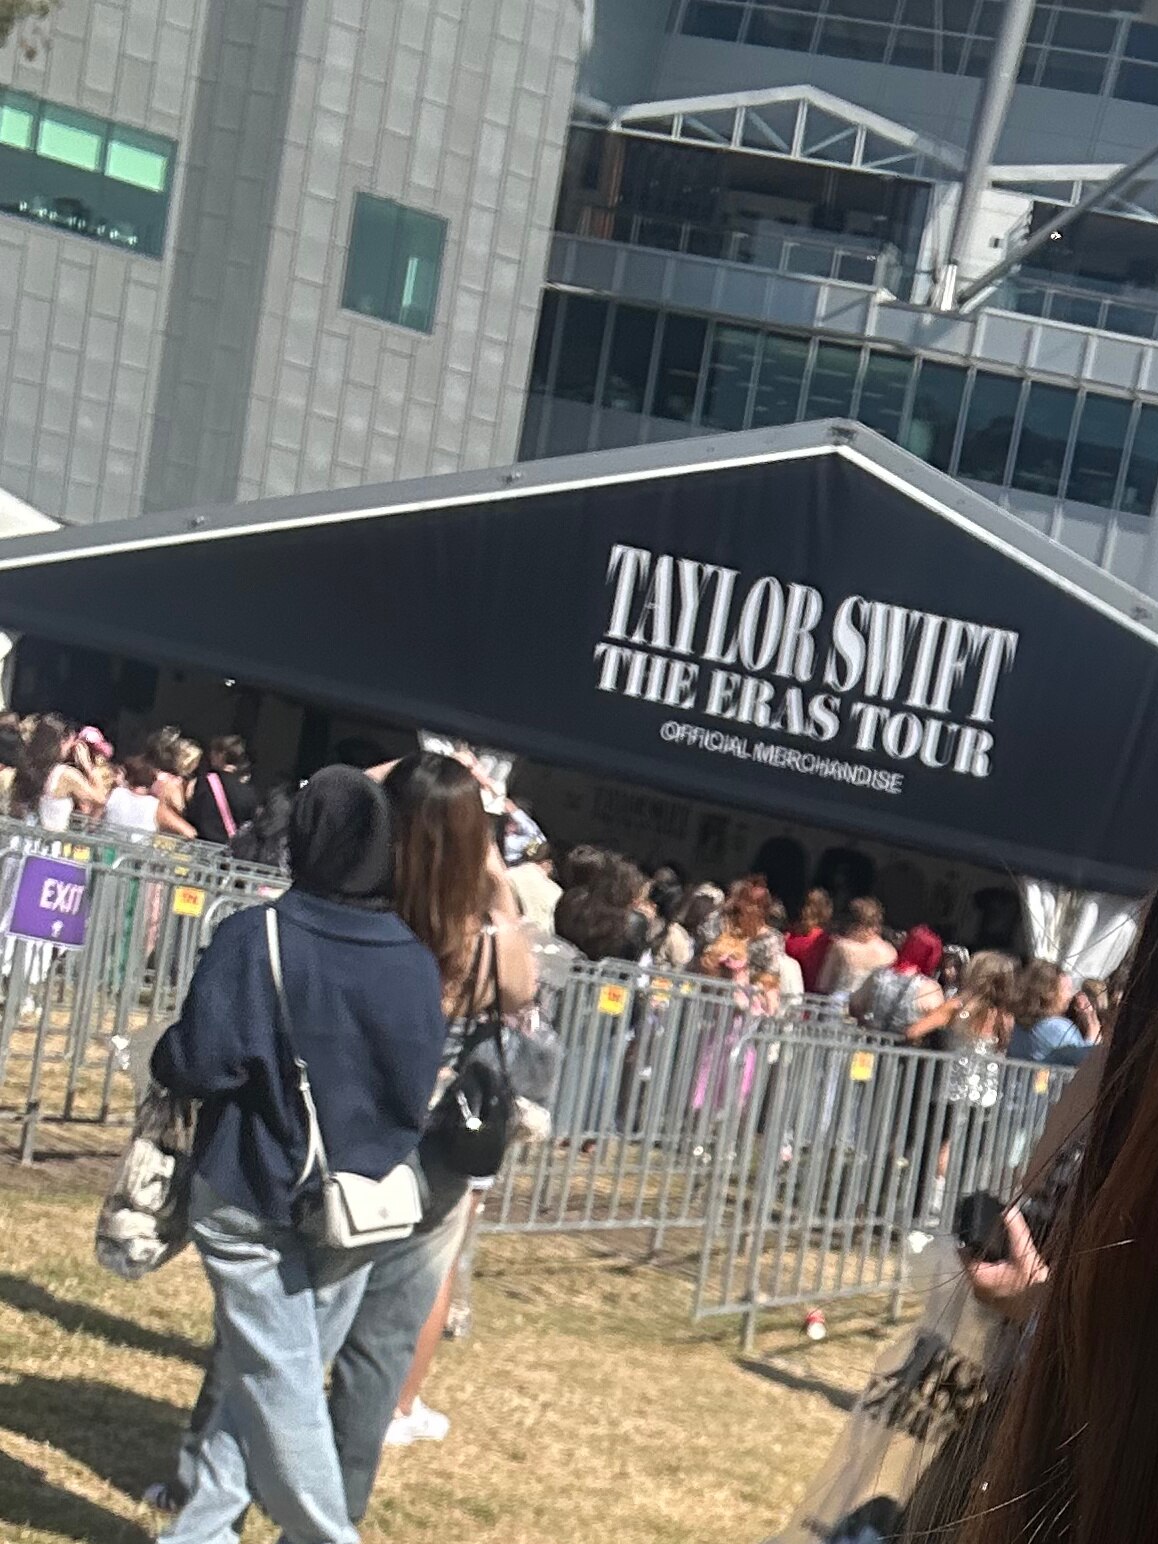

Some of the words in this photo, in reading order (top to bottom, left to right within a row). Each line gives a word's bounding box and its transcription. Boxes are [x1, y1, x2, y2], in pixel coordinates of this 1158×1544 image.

[606, 544, 823, 682] TAYLOR
[823, 595, 1019, 723] SWIFT
[594, 642, 699, 710] THE
[704, 669, 841, 741] ERAS
[851, 702, 994, 778] TOUR
[660, 720, 751, 758] OFFICIAL
[752, 741, 905, 795] MERCHANDISE
[40, 878, 85, 915] EXIT
